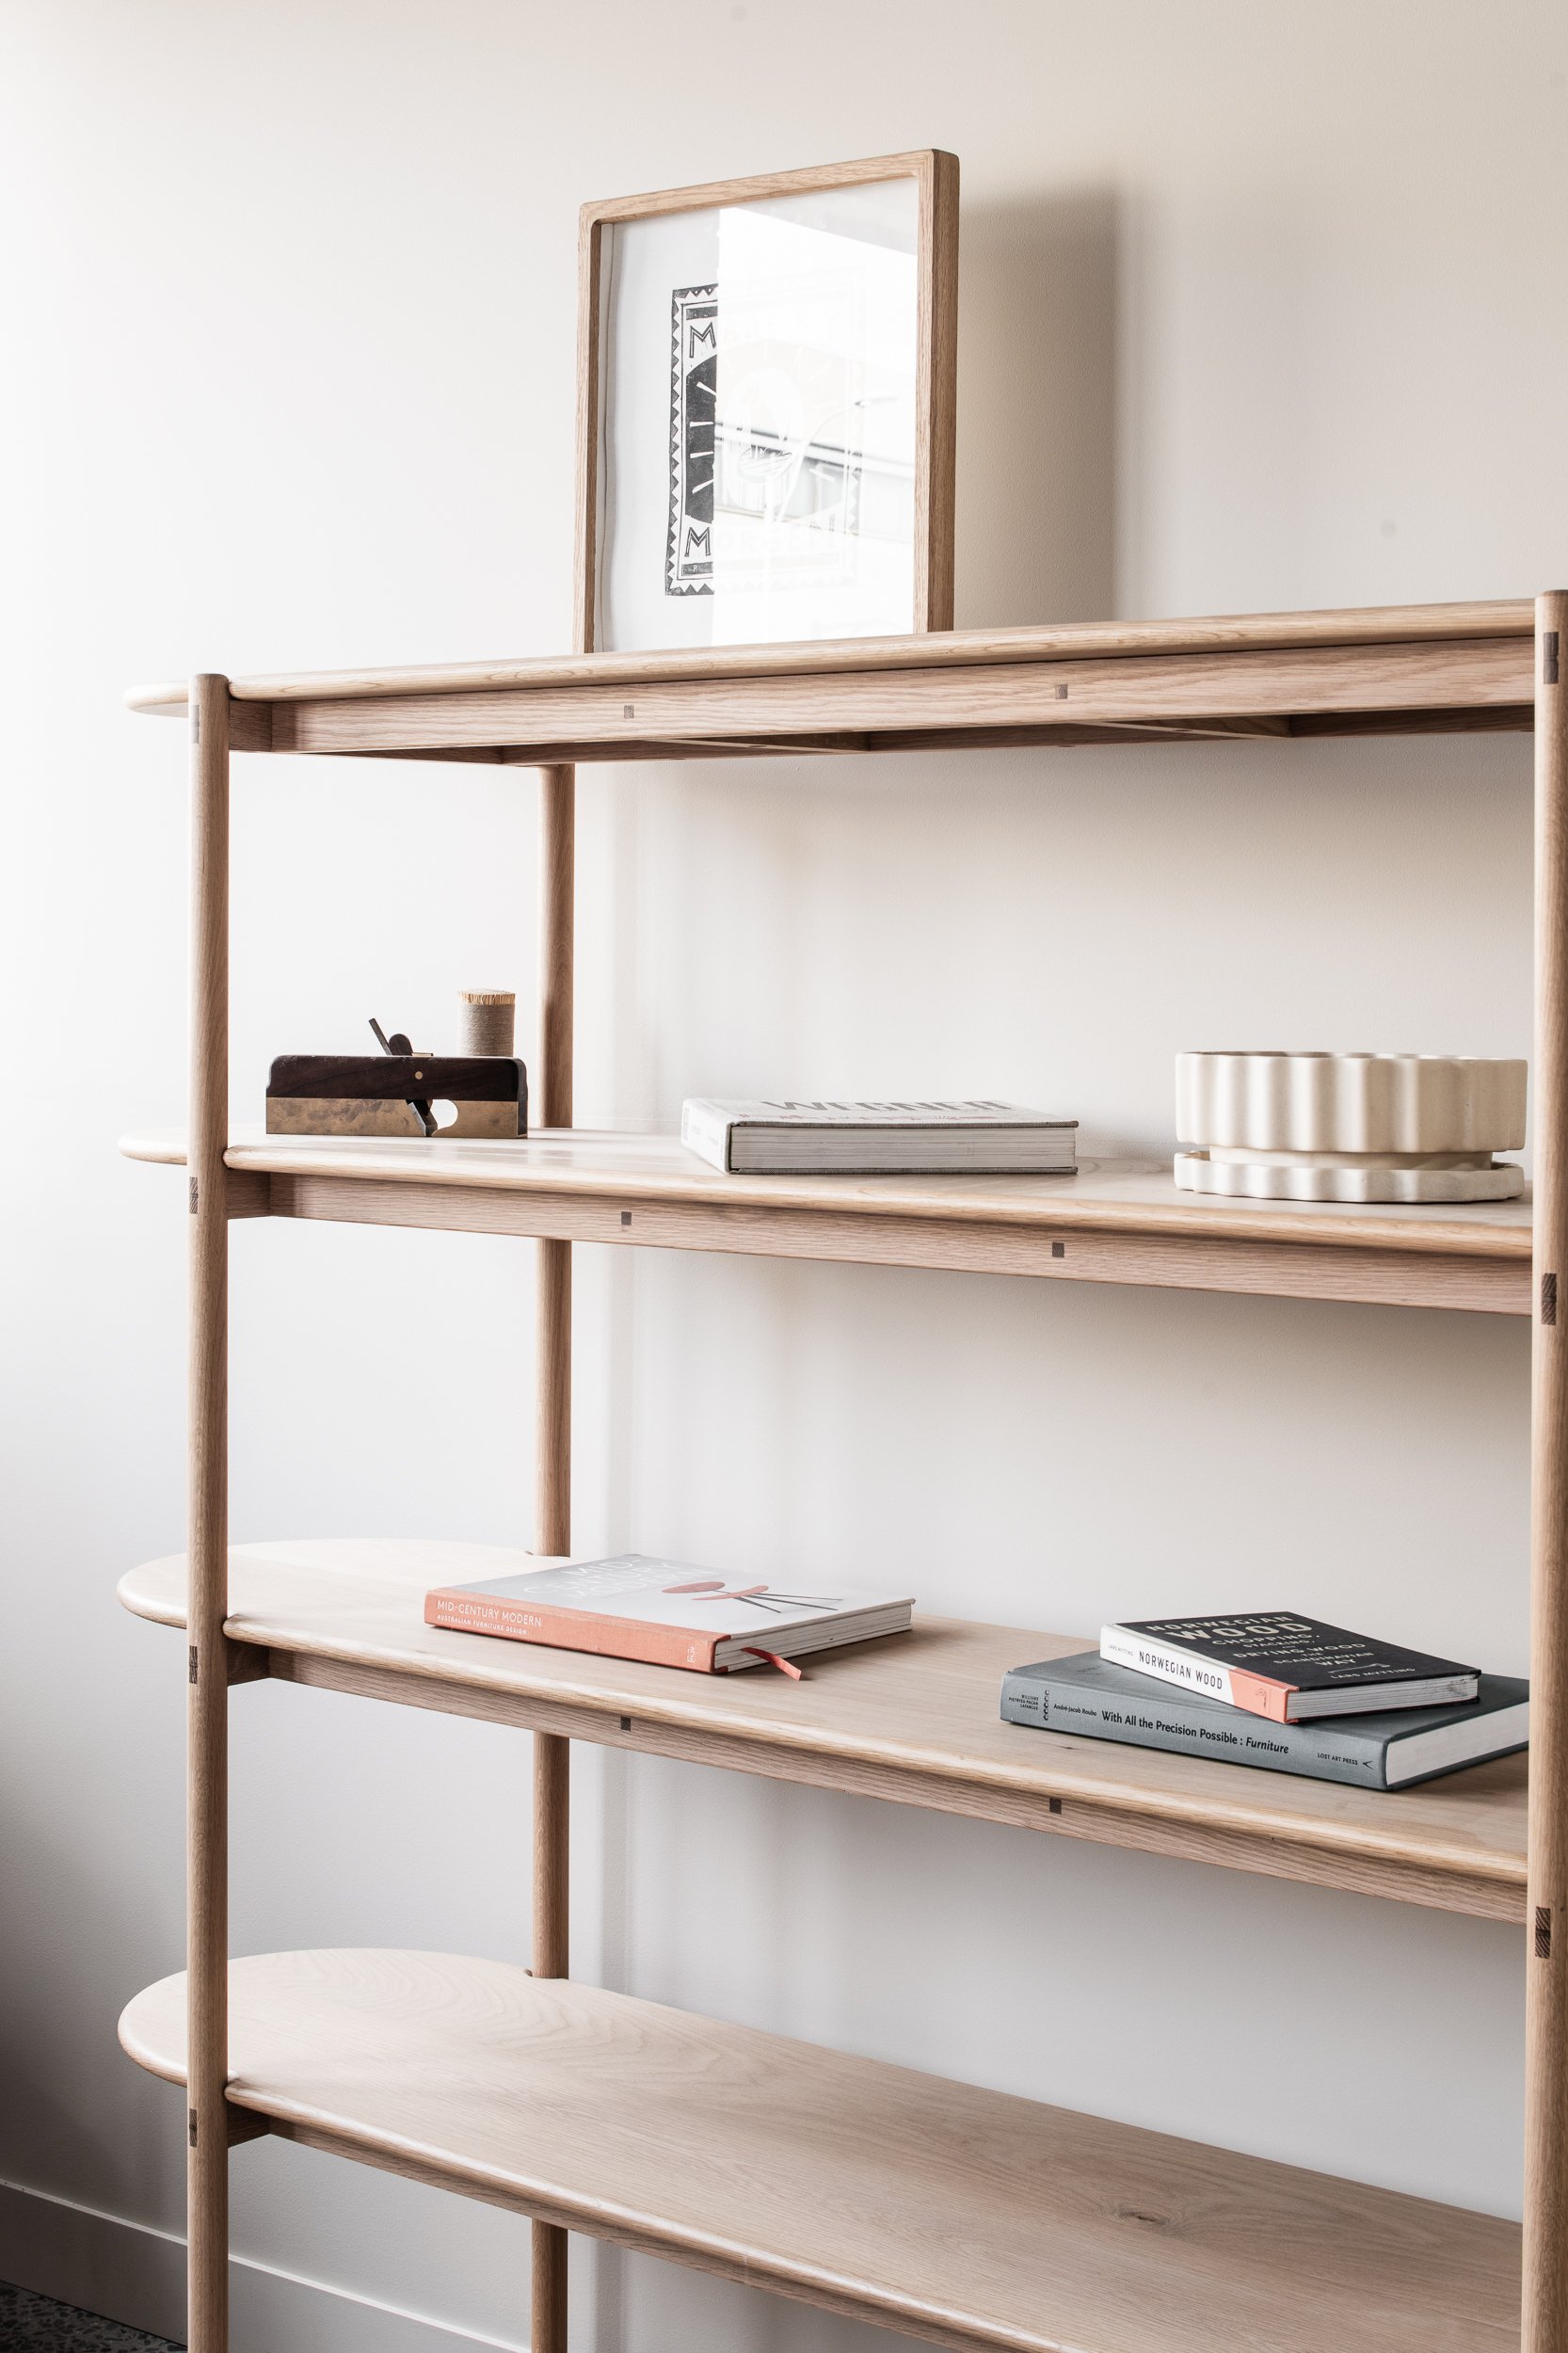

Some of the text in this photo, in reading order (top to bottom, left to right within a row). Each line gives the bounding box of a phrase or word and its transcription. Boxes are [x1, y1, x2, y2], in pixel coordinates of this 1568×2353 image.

[524, 1562, 678, 1594] CENTURY
[567, 1567, 716, 1598] MODERN
[437, 1600, 541, 1627] MID-CENTURY MODERN
[437, 1614, 527, 1635] AUSTRALIAN FURNITURE DESIGN
[1146, 1616, 1293, 1632] NORWEGIAN
[1165, 1623, 1313, 1641] WOOD
[1213, 1633, 1320, 1645] CHOPPING,
[1232, 1643, 1367, 1658] DRYING WOOD
[1243, 1640, 1316, 1649] STACKING,
[1273, 1652, 1374, 1664] SCANDINAVIAN
[1315, 1658, 1357, 1667] WAY
[1139, 1650, 1223, 1690] NORWEGIAN WOOD
[1363, 1667, 1416, 1676] MYTTING
[1053, 1704, 1097, 1717] André-Jacob Roubo
[1101, 1710, 1123, 1724] With
[1125, 1715, 1137, 1726] All
[1139, 1717, 1154, 1729] the
[1156, 1720, 1197, 1737] Precision
[1199, 1728, 1238, 1744] Possible
[1245, 1737, 1289, 1754] Furniture
[1317, 1753, 1358, 1766] LOST ART PRESS
